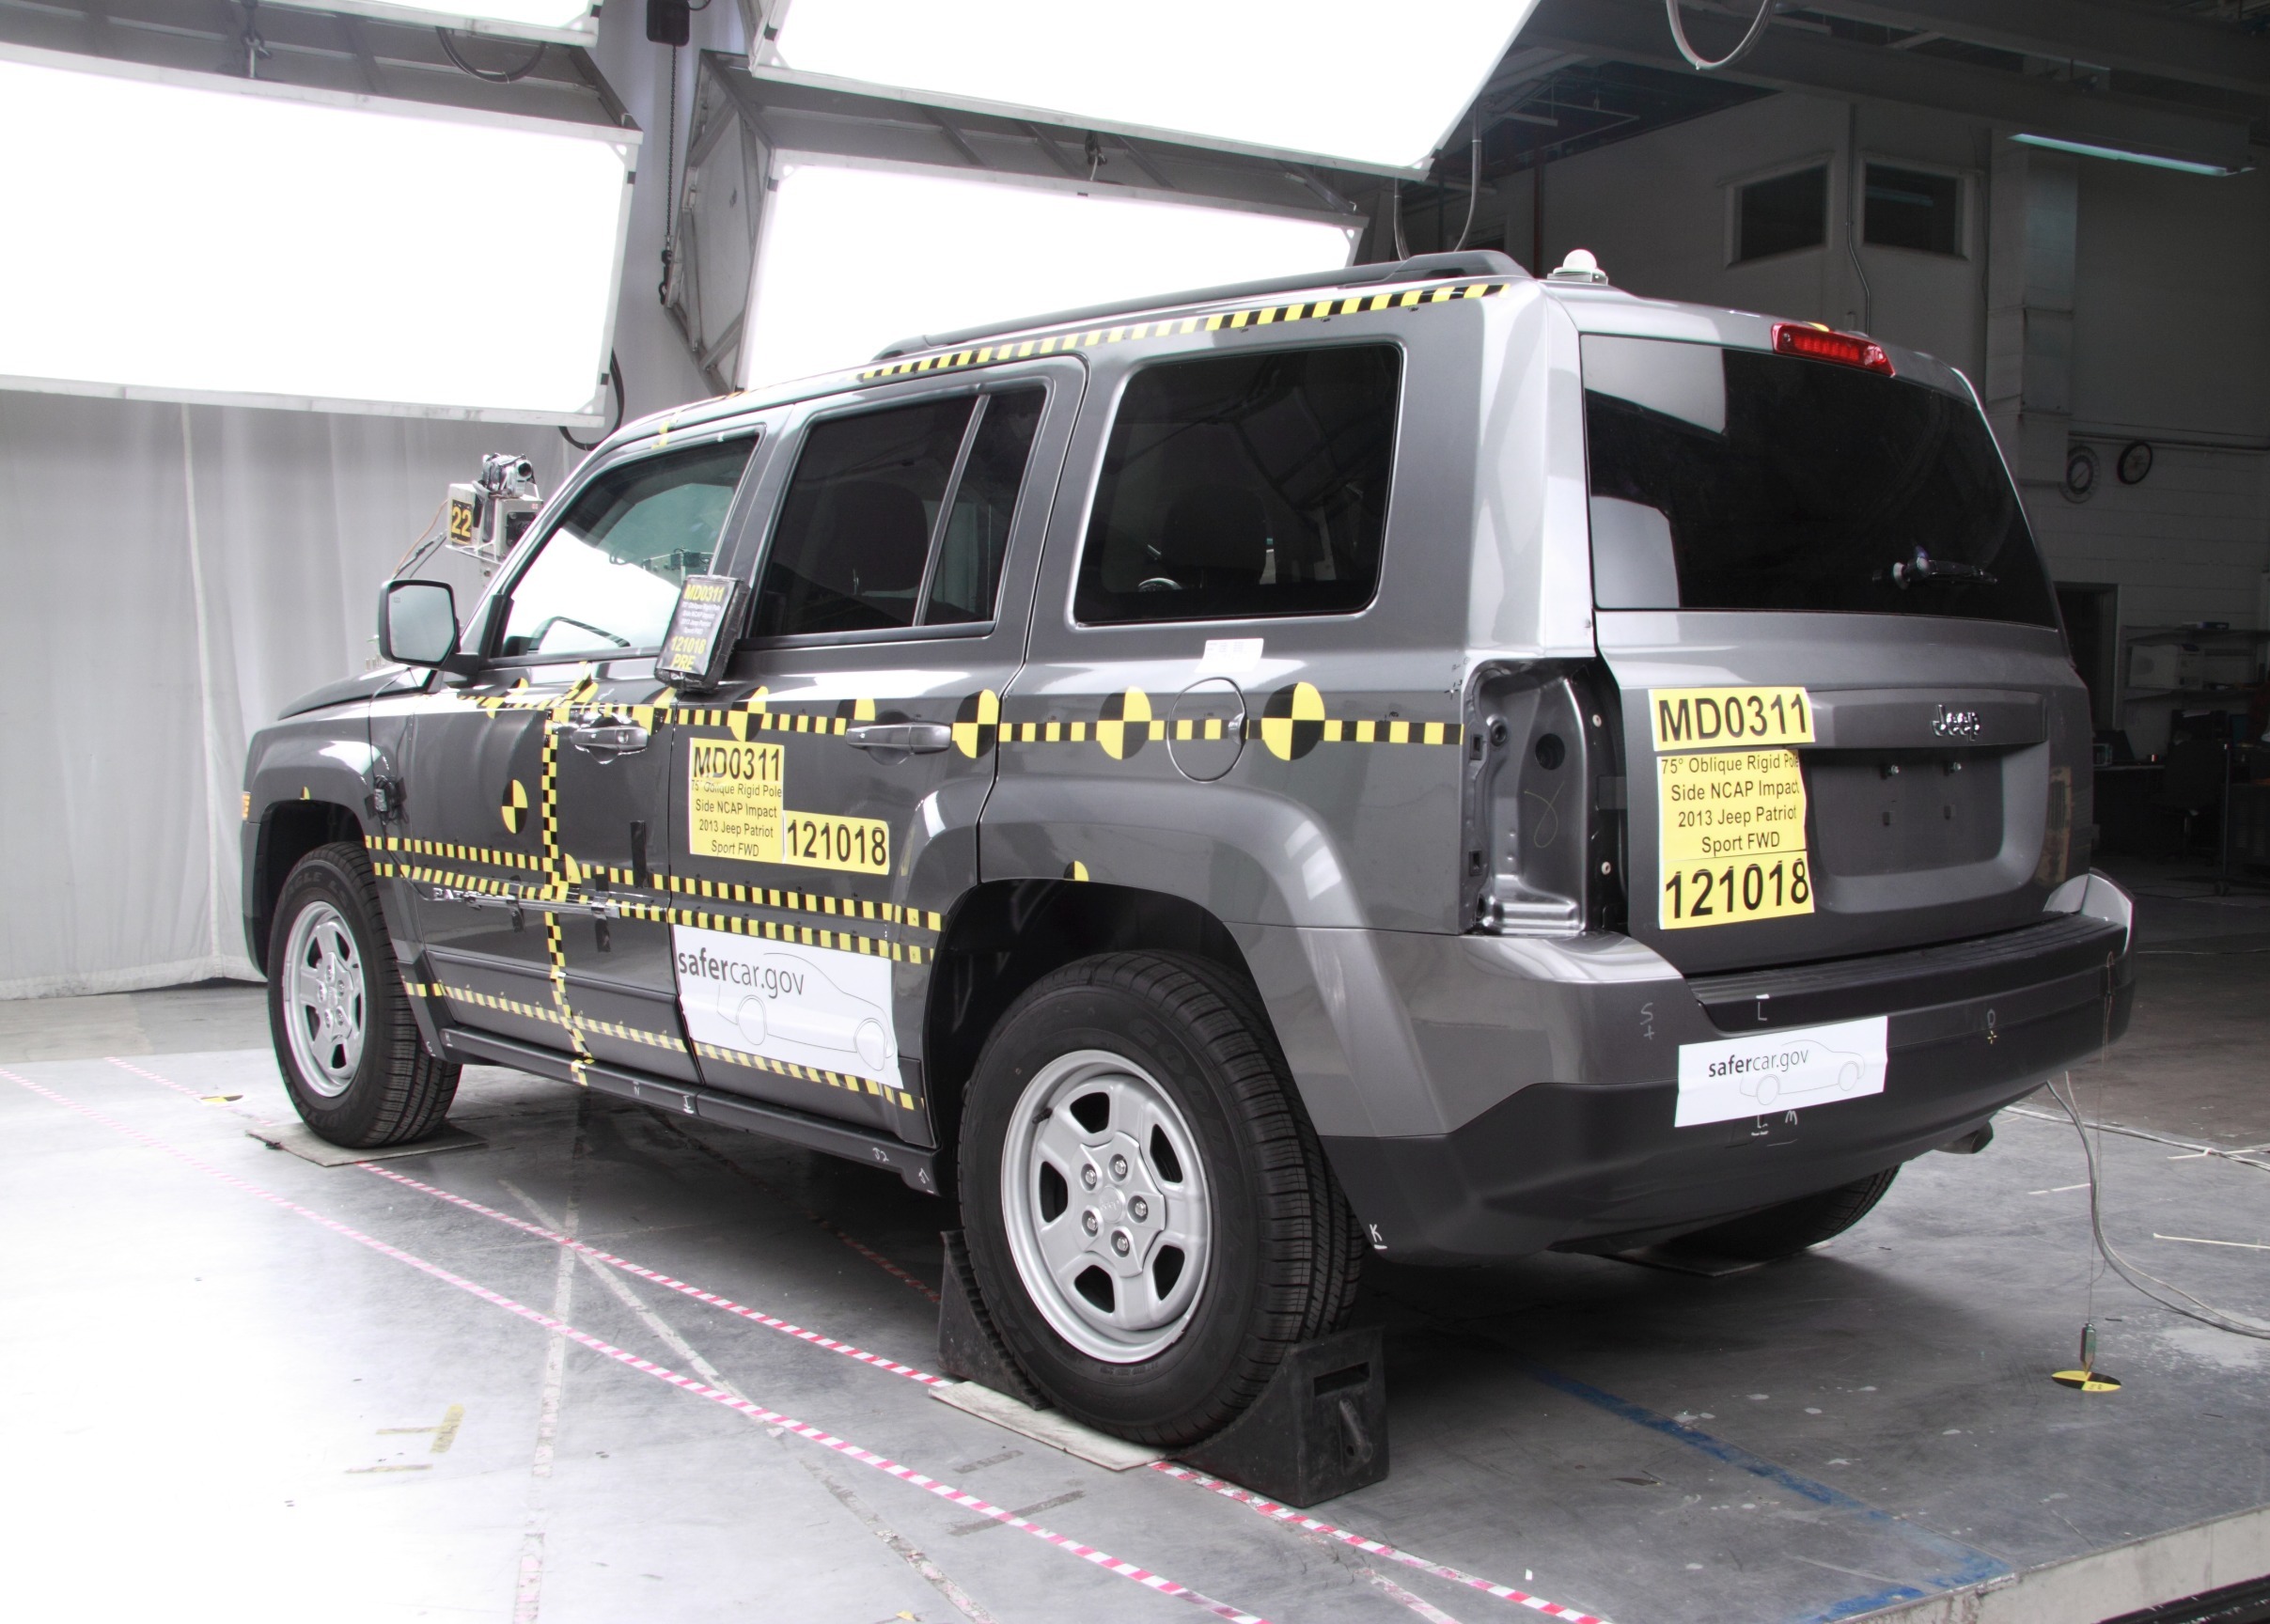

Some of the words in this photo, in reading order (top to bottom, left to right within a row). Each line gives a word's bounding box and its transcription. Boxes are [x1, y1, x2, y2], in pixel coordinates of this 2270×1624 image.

[451, 506, 472, 538] 22
[683, 585, 725, 602] MD0311
[670, 636, 707, 654] 121018
[670, 654, 696, 671] PRE
[1658, 693, 1807, 742] MD0311
[1932, 704, 1980, 742] Jeep
[694, 746, 779, 781] MD0311
[1661, 757, 1683, 774] 75°
[1688, 757, 1743, 775] Oblique
[1747, 754, 1780, 773] Rigid
[738, 783, 759, 798] Rigid
[763, 785, 782, 797] Pole
[1671, 784, 1705, 801] Side
[1711, 781, 1754, 799] NCAP
[1759, 779, 1800, 798] Impact
[696, 799, 714, 813] Side
[717, 801, 743, 815] NCAP
[745, 803, 777, 820] Impact
[1678, 809, 1713, 828] 2013
[1717, 808, 1751, 827] Jeep
[1756, 804, 1797, 822] Patriot
[699, 819, 719, 833] 2013
[721, 821, 741, 836] Jeep
[744, 822, 774, 838] Patriot
[712, 839, 735, 856] Sport
[738, 842, 759, 857] FWD
[787, 820, 888, 867] 121018
[1701, 834, 1743, 857] Sport
[1747, 831, 1780, 850] FWD
[1665, 857, 1809, 919] 121018
[678, 947, 805, 999] safercar.gov
[1757, 1001, 1768, 1021] L
[1708, 1049, 1809, 1078] safercar.gov
[1370, 1224, 1383, 1242] K
